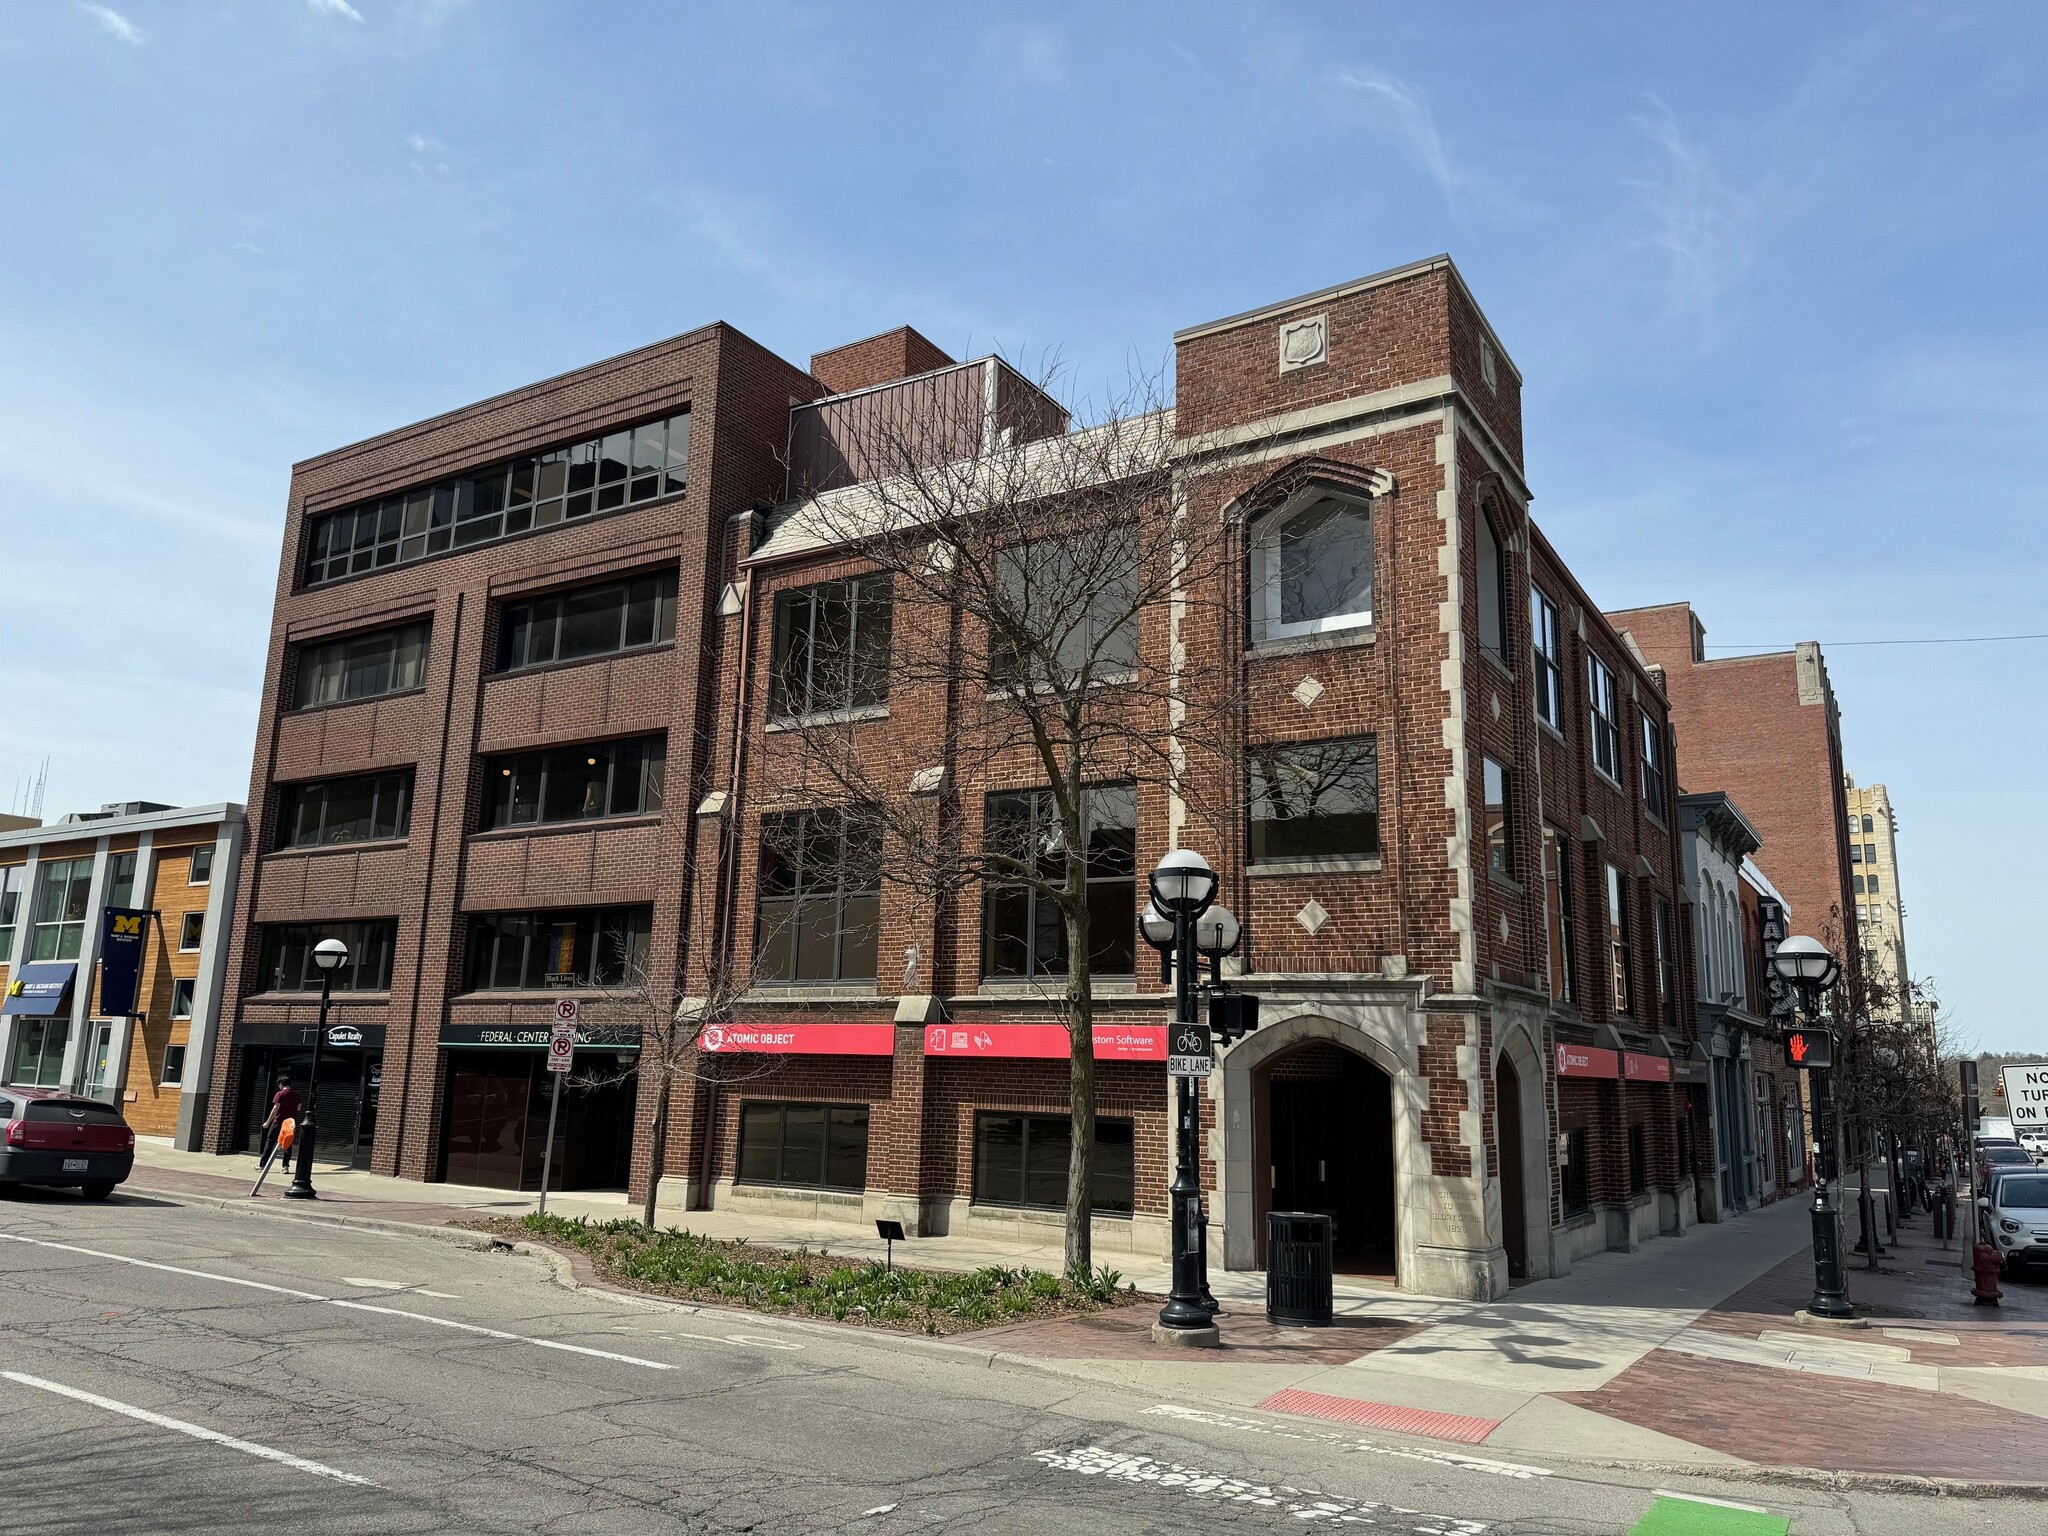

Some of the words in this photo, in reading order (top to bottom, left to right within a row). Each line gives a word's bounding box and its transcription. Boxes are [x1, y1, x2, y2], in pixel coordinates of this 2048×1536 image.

[113, 915, 141, 934] M
[6, 980, 24, 996] M
[328, 1031, 347, 1042] Capulet
[347, 1032, 363, 1043] Realty
[480, 1031, 513, 1043] FEDERAL
[516, 1031, 549, 1044] CENTER
[726, 1033, 759, 1045] ATOMIC
[760, 1033, 795, 1045] OBJECT
[1092, 1035, 1115, 1045] stom
[1116, 1034, 1153, 1046] Software
[1170, 1057, 1187, 1072] BIKE
[1190, 1058, 1209, 1073] LANE
[2026, 1072, 2048, 1084] NO
[2021, 1090, 2048, 1101] TUR
[2016, 1107, 2036, 1119] ON
